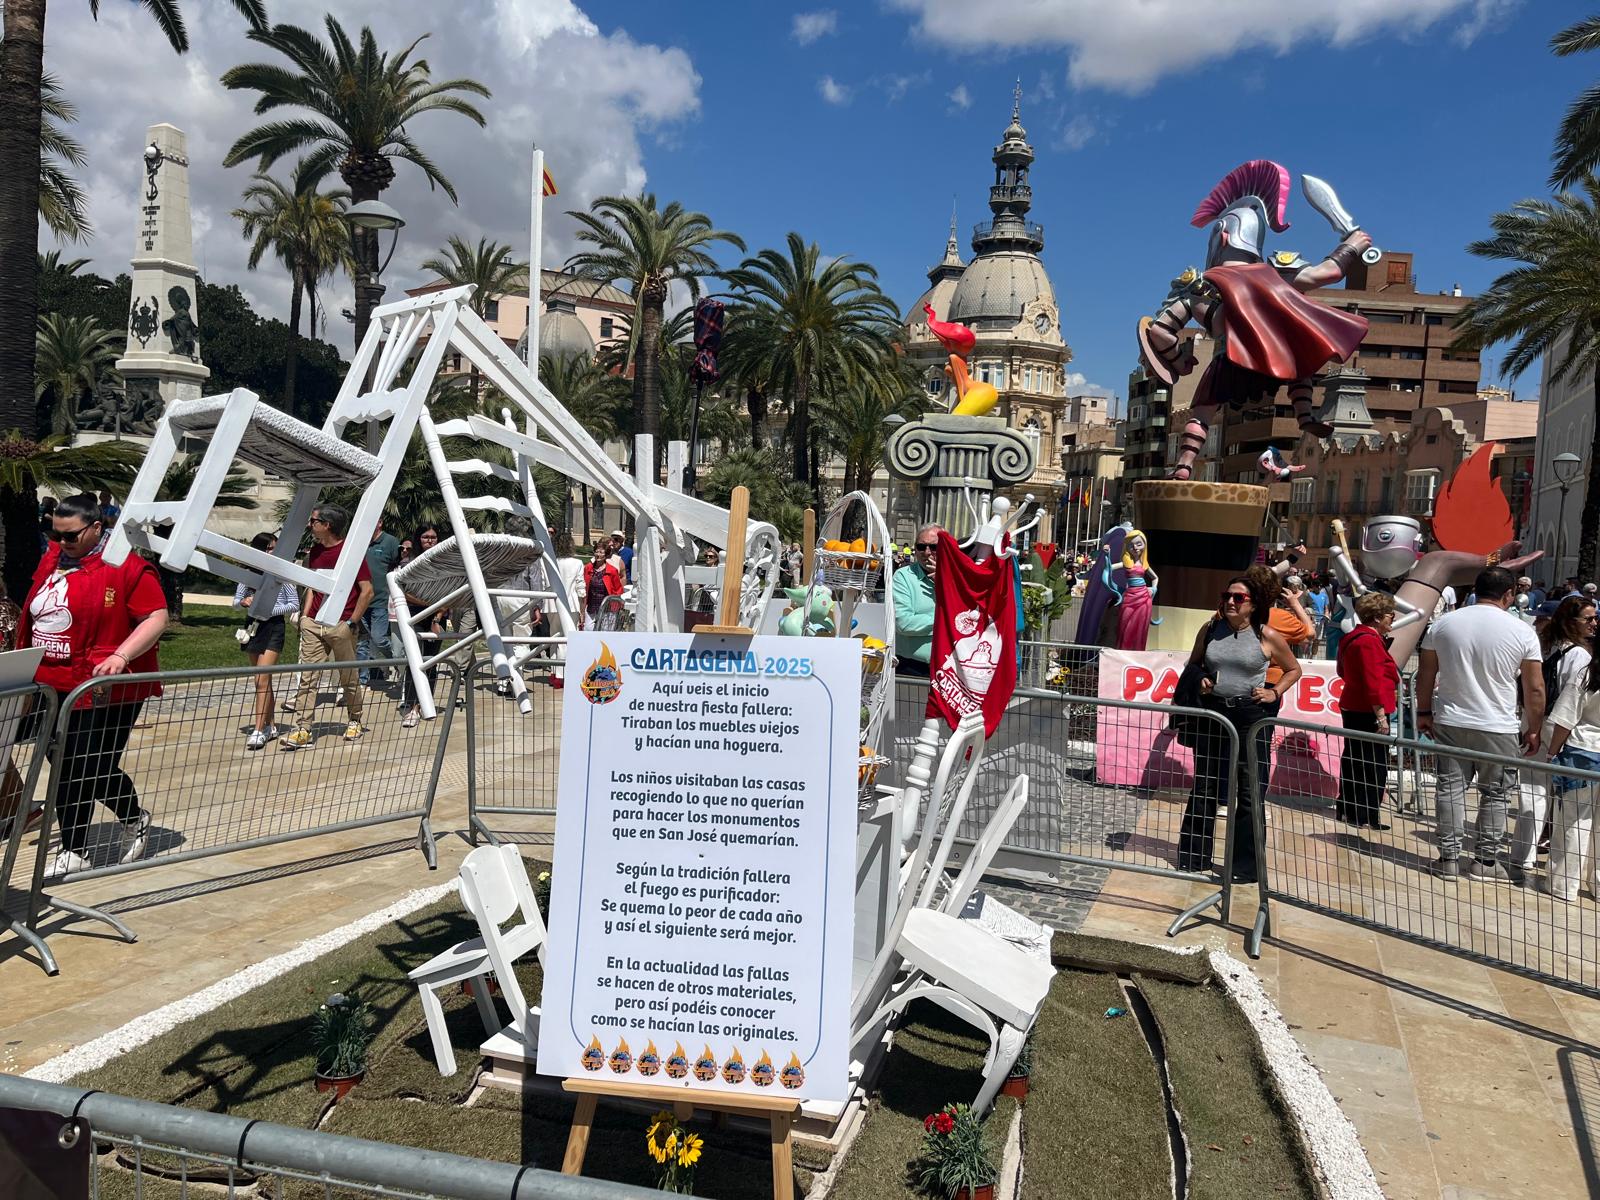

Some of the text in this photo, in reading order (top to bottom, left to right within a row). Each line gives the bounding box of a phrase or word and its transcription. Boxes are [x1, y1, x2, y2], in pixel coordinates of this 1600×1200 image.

[630, 647, 812, 675] CARTAGENA 2025
[651, 680, 770, 698] Aquí veis el inicio
[629, 699, 793, 718] de nuestra fiesta fallera:
[620, 715, 800, 738] Tiraban los muebles viejos
[635, 733, 783, 756] y hacían una hoguera.
[610, 770, 806, 792] Los niños visitaban las casas
[610, 788, 804, 811] recogiendo lo que no querían
[612, 807, 801, 829] para hacer los monumentos
[612, 827, 799, 848] que en San José quemarían.
[615, 861, 791, 886] Según la tradición fallera
[625, 881, 780, 904] el fuego es purificador:
[601, 899, 803, 925] Se quema lo peor de cada año
[605, 917, 797, 946] y así el siguiente será mejor.
[607, 956, 790, 983] En la actualidad las fallas
[597, 975, 797, 1005] se hacen de otros materiales,
[614, 996, 776, 1020] pero así podéis conocer
[590, 1014, 799, 1042] como se hacían las originales.
